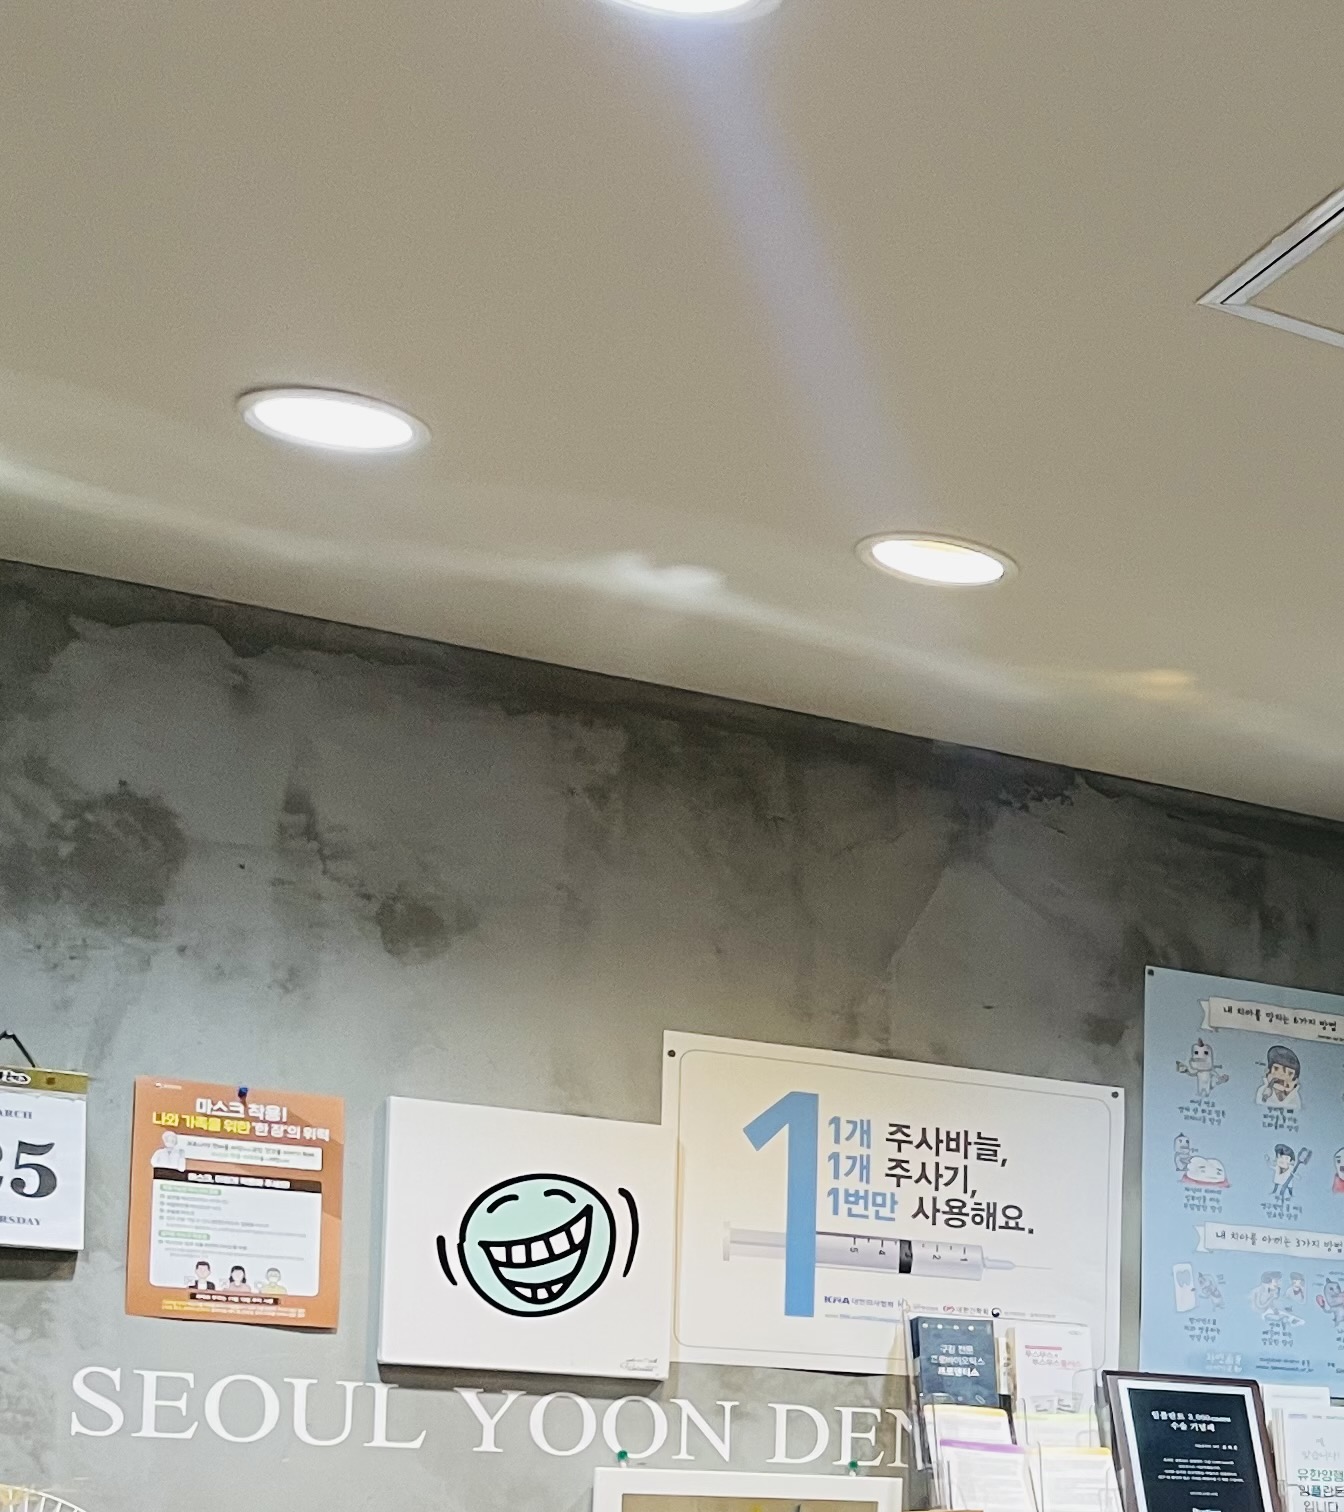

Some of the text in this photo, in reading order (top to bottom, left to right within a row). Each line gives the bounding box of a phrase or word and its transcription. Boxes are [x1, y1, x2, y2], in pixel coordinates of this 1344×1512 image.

[1223, 1005, 1233, 1014] 내
[152, 1110, 180, 1127] 나와
[195, 1097, 246, 1119] 마스크
[826, 1117, 1010, 1167] 1개 주사바늘,
[826, 1151, 978, 1199] 1개 주사기,
[742, 1090, 820, 1318] 1
[826, 1187, 1035, 1236] 1번만 사용해요.
[1215, 1231, 1226, 1241] 내
[70, 1365, 429, 1452] SEOUL
[451, 1386, 733, 1465] YOON
[1297, 1468, 1344, 1483] 유한양행
